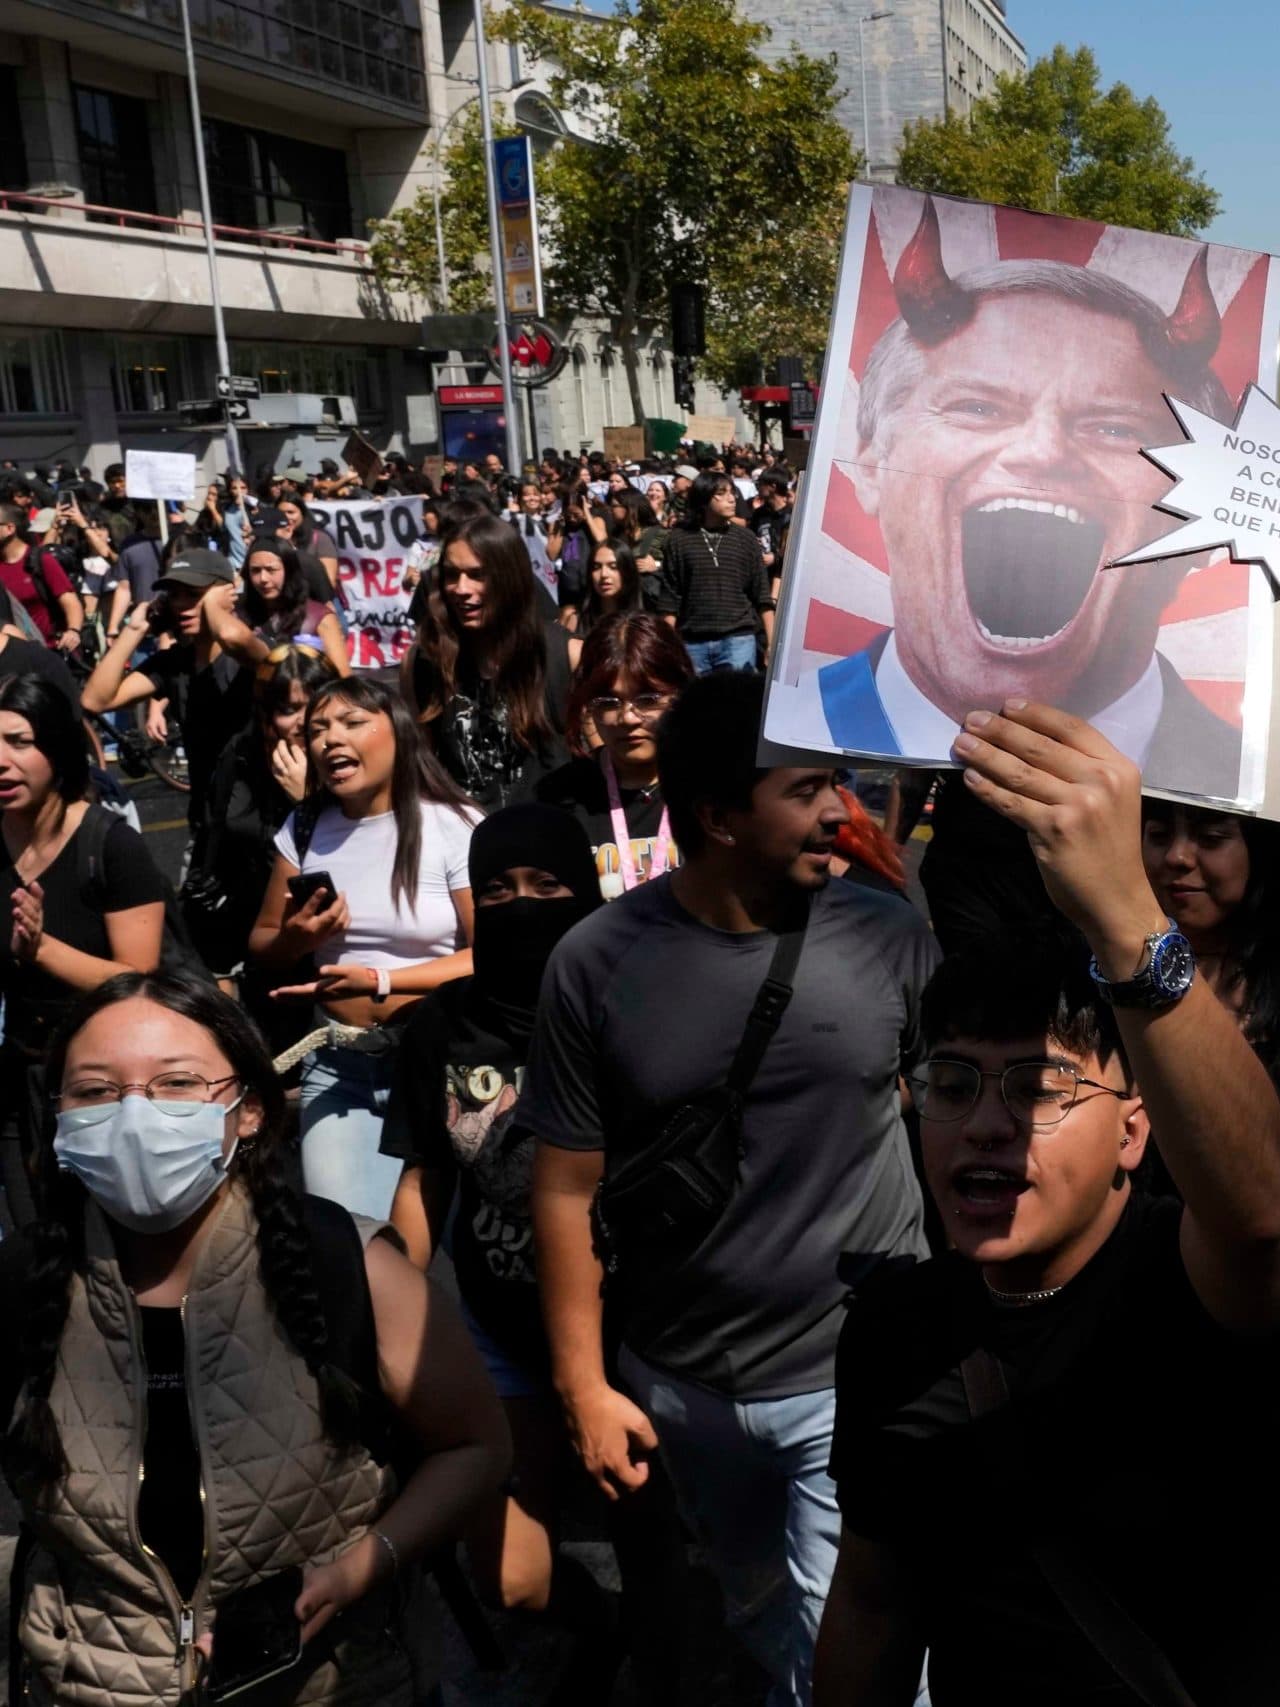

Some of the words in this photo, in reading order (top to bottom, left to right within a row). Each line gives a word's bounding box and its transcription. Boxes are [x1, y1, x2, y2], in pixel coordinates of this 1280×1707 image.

[1236, 465, 1253, 481] A
[1213, 507, 1262, 533] QUE
[337, 557, 412, 599] PRE
